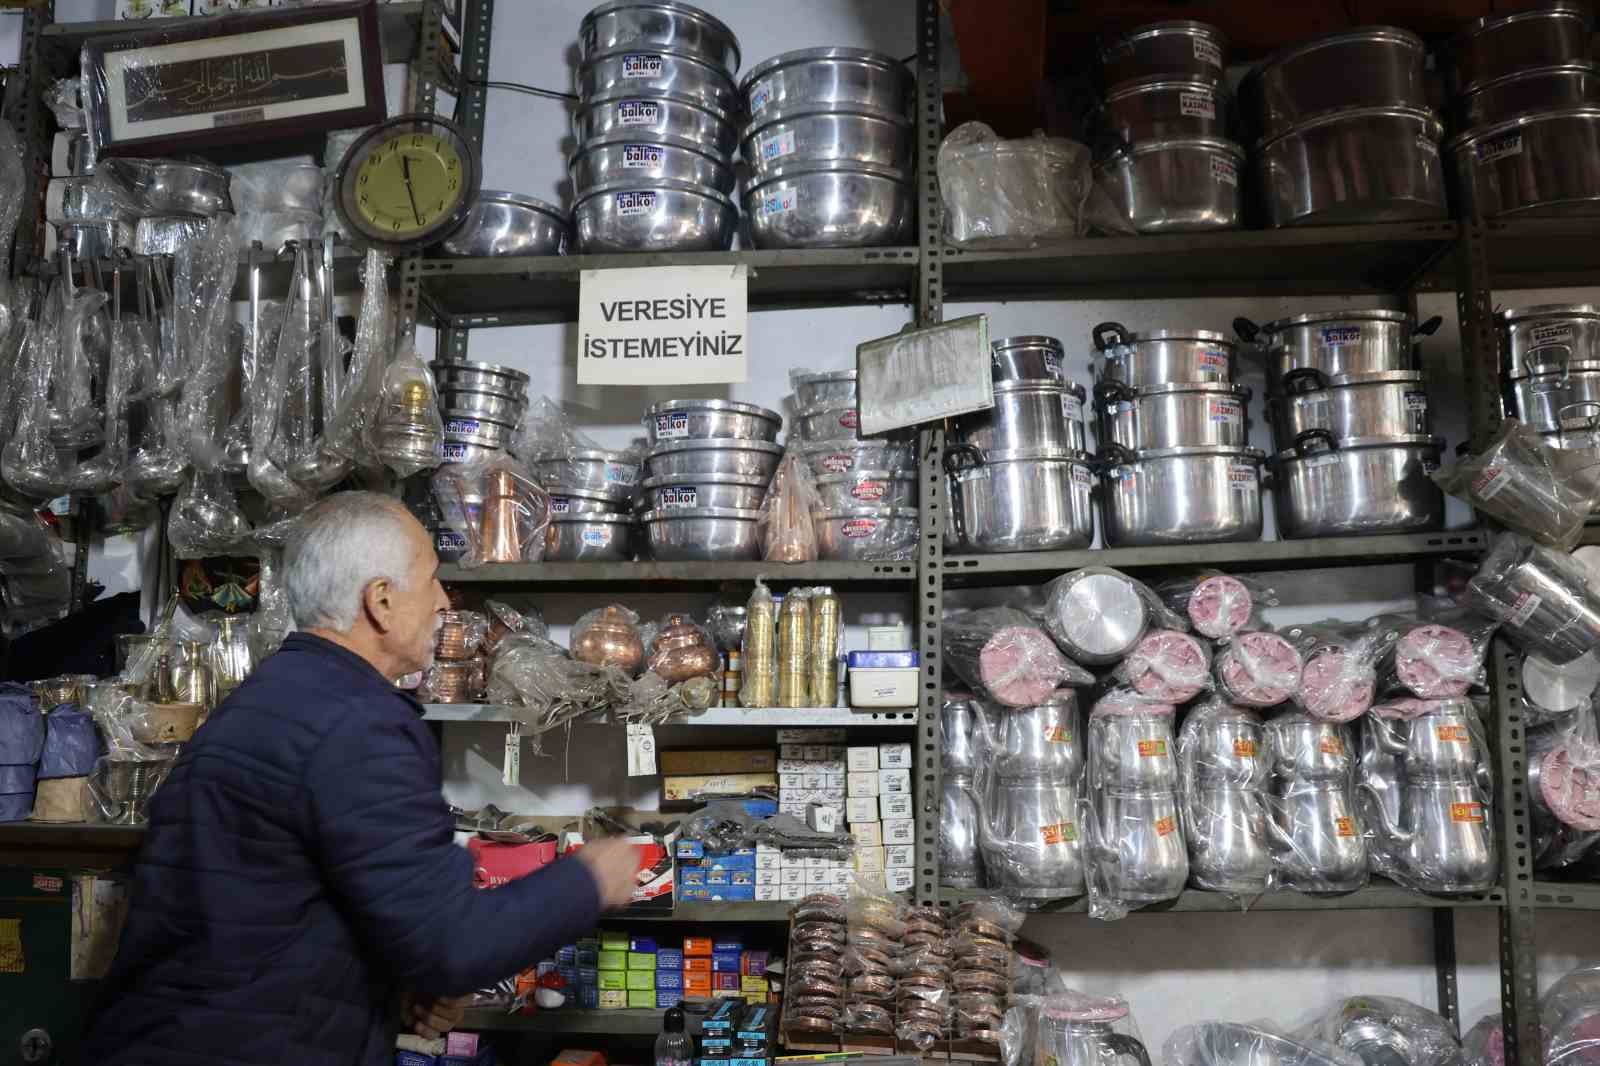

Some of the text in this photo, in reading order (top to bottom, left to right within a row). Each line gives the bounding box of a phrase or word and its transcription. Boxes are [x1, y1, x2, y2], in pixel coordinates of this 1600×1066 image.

[625, 58, 661, 72] balkor
[621, 104, 657, 118] balkor
[619, 194, 656, 209] balkor
[600, 294, 726, 321] VERESİYE
[1326, 332, 1360, 342] balkor
[584, 330, 742, 359] İSTEMEYİNİZ
[658, 416, 686, 430] balkor
[443, 447, 465, 458] alkor
[663, 491, 696, 503] balkor
[552, 502, 567, 511] kor
[439, 535, 465, 546] balko
